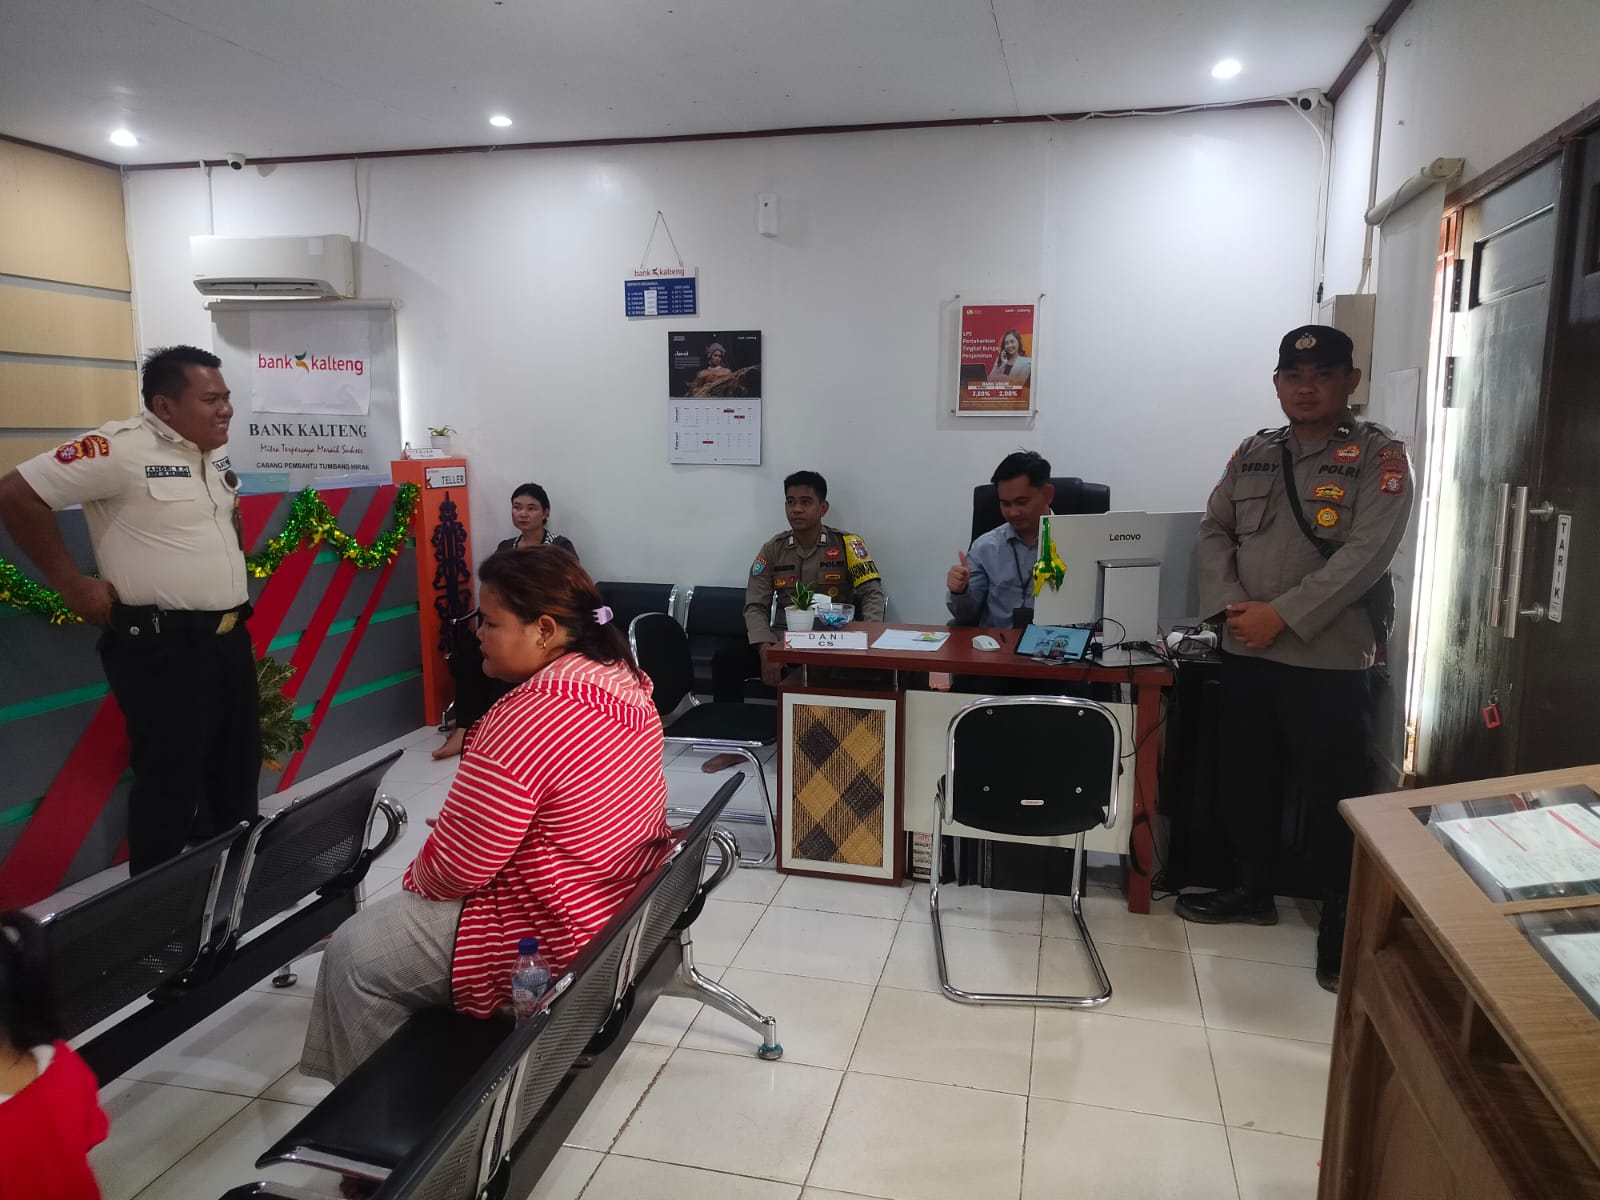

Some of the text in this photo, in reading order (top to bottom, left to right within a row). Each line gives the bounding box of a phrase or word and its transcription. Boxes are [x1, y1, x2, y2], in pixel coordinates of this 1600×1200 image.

[634, 268, 685, 278] bank kalteng
[258, 353, 364, 376] bank kalteng
[249, 424, 367, 438] BANK KALTENG
[260, 444, 280, 453] Mitra
[284, 462, 318, 470] PEMBANTU
[1241, 463, 1279, 473] DEDDY
[1318, 465, 1361, 479] POLRI
[441, 475, 465, 485] TELLER
[1109, 533, 1142, 542] Lenovo
[1553, 522, 1567, 600] TARIK
[808, 633, 844, 641] DANI
